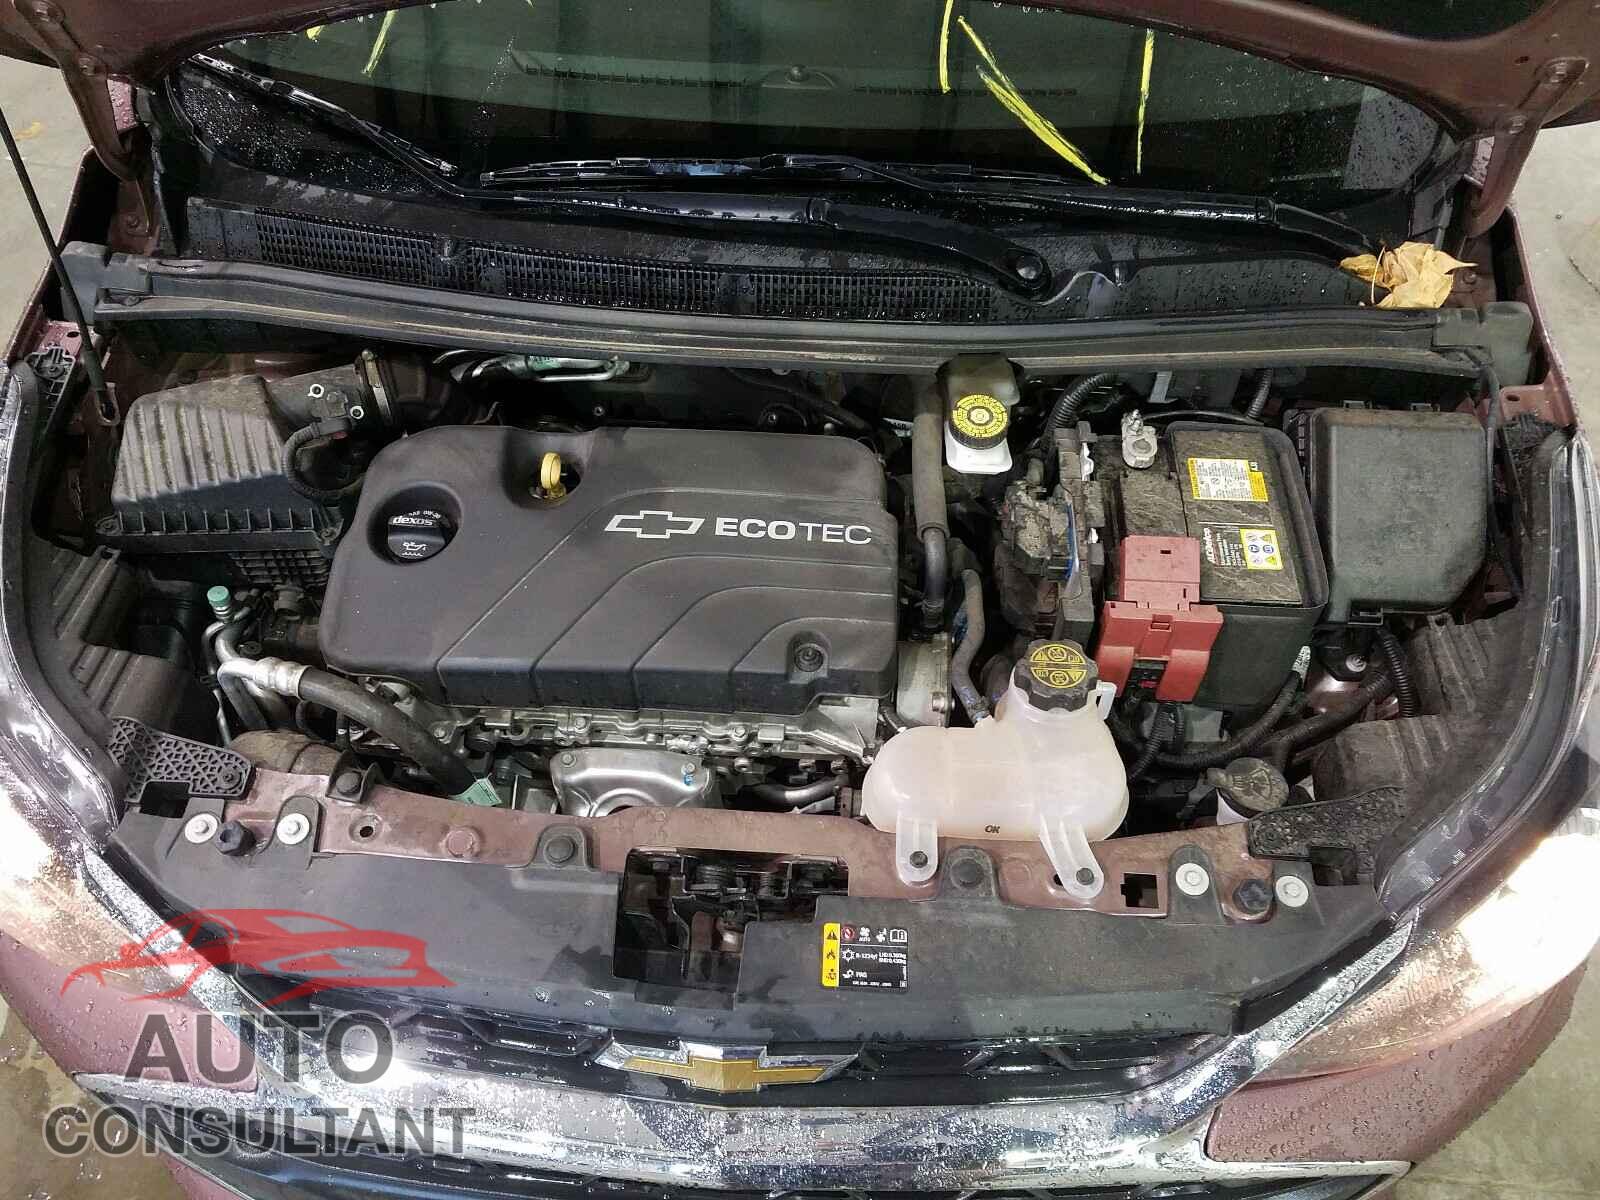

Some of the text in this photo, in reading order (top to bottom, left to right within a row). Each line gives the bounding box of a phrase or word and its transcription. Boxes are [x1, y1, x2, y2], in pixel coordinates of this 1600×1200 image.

[392, 516, 433, 526] dexos
[715, 517, 872, 545] ECOTEC
[984, 824, 1001, 834] OK
